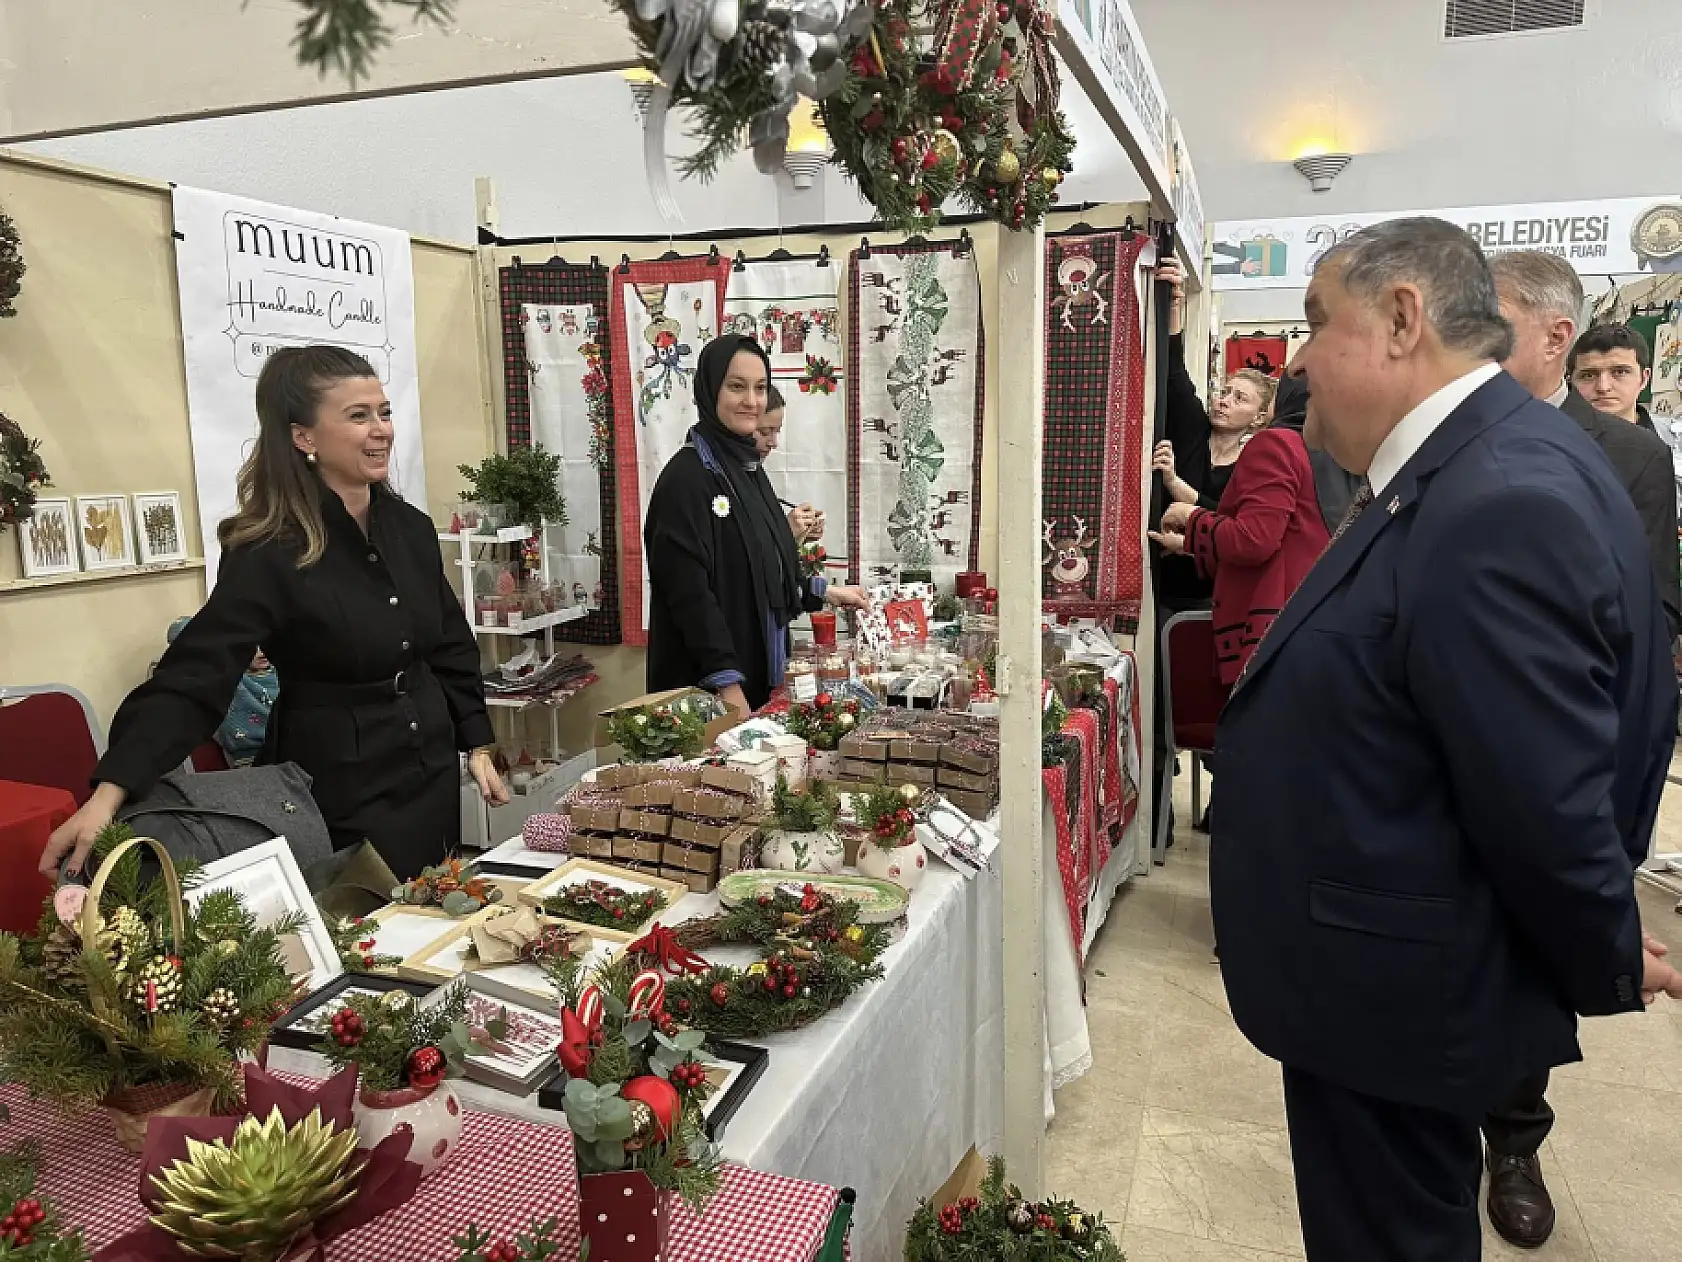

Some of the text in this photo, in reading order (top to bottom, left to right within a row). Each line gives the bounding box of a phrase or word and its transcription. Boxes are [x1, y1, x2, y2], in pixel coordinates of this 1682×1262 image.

[234, 220, 374, 276] muum
[226, 279, 382, 329] Handmade Candle
